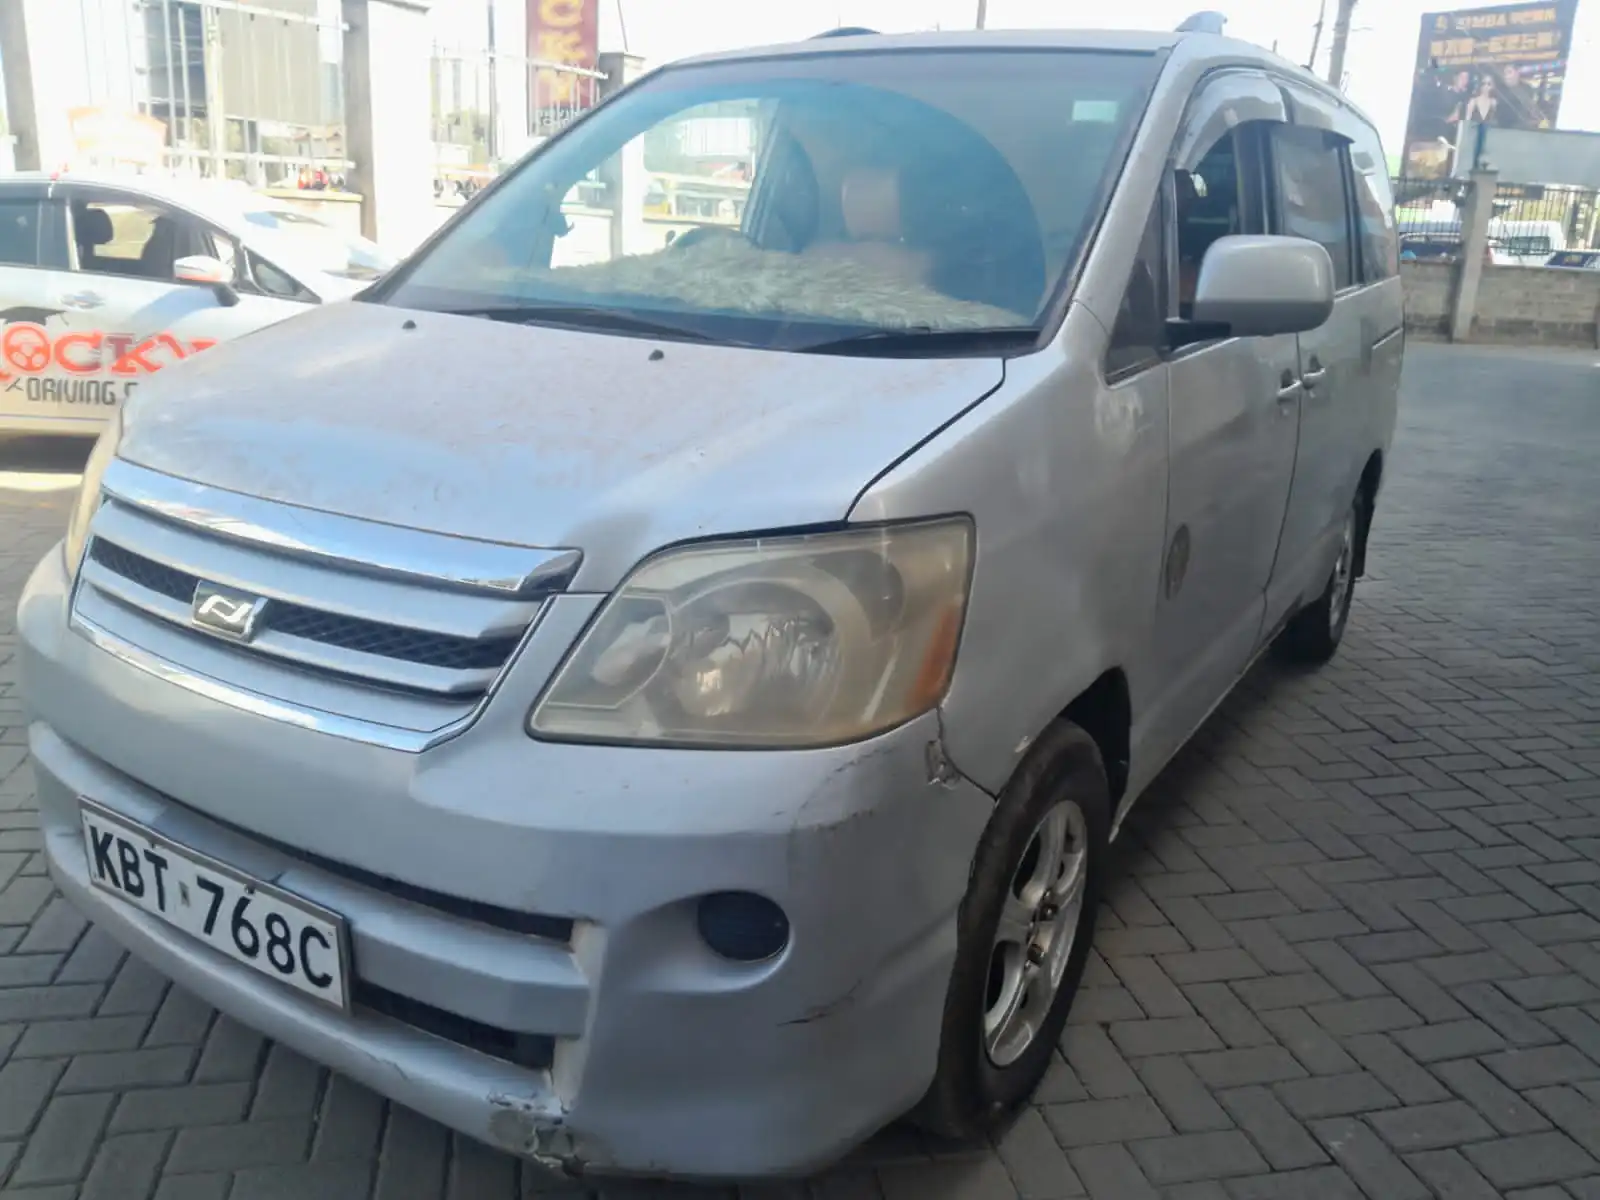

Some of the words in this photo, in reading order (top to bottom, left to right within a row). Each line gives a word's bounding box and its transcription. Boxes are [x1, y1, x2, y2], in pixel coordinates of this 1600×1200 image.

[26, 377, 117, 406] DRIVING
[89, 826, 169, 912] KBT
[196, 875, 333, 988] 768C
